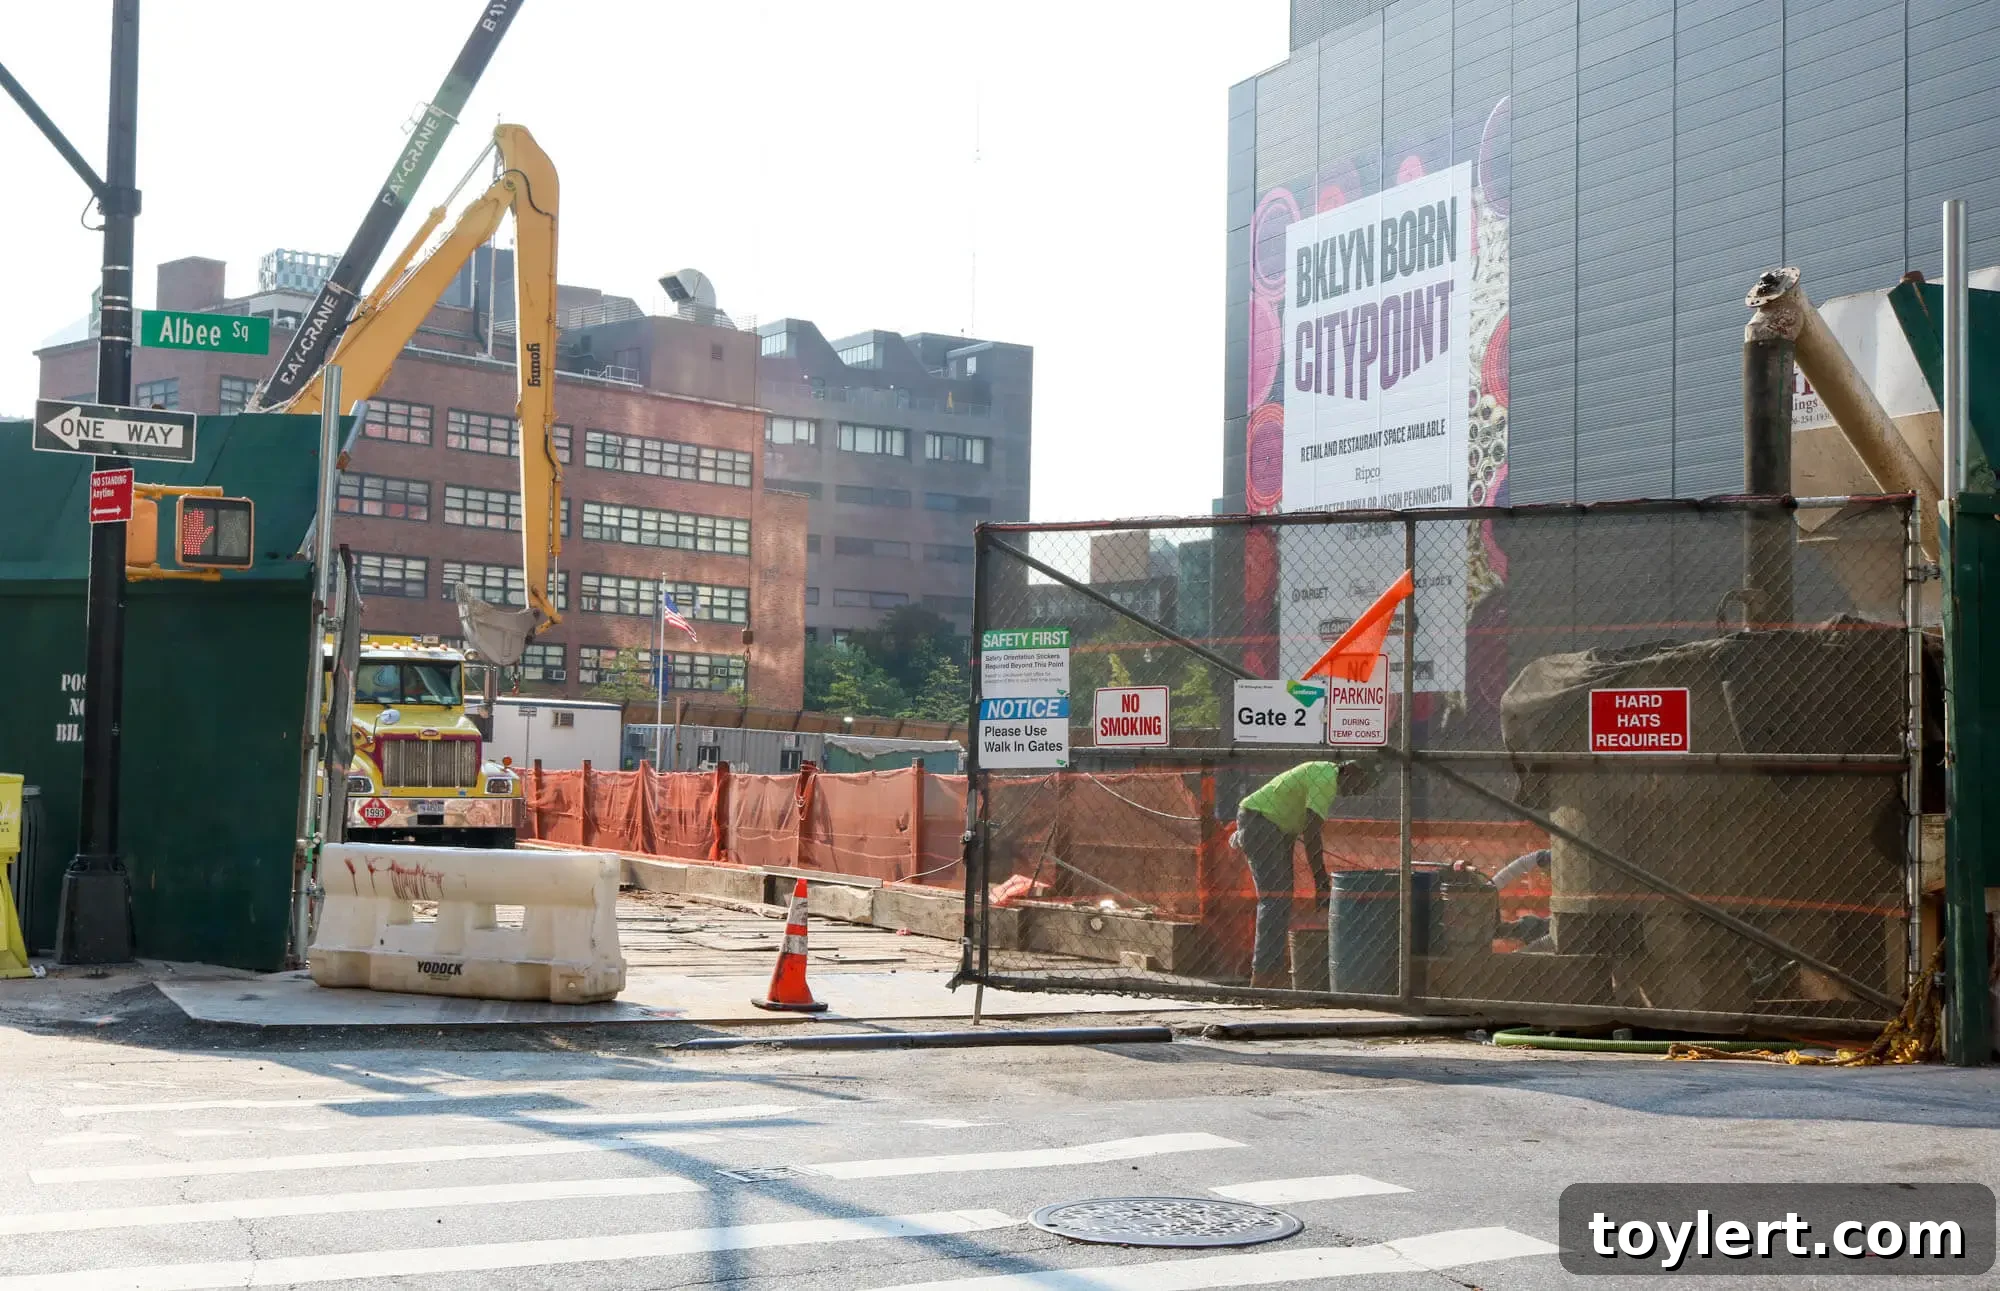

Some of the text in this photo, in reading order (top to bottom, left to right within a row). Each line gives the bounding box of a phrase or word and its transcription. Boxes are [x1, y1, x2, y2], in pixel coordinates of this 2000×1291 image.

[1296, 196, 1458, 308] BKLYN BORN
[159, 316, 249, 346] Albee Sq
[1794, 398, 1818, 413] ings
[61, 417, 174, 445] ONE WAY
[1300, 418, 1446, 462] RETAIL AND RESTAURANT SPACE AVAILABLE
[93, 474, 128, 487] NO STANDING
[1355, 465, 1381, 484] Ripco
[93, 488, 115, 500] Anytime
[1378, 491, 1402, 510] JASON
[1403, 484, 1453, 507] PENNINGTON
[983, 630, 1070, 648] SAFETY FIRST
[1011, 662, 1033, 670] Beyond
[61, 673, 87, 692] POS
[1122, 693, 1140, 713] NO
[1333, 687, 1384, 705] PARKING
[1615, 694, 1663, 708] HARD
[987, 699, 1060, 718] NOTICE
[1238, 707, 1306, 726] Gate 2
[1100, 715, 1162, 737] SMOKING
[1342, 718, 1370, 726] DURING
[1617, 714, 1661, 728] HATS
[56, 723, 82, 742] BIL
[984, 725, 1047, 737] Please Use
[1333, 730, 1353, 738] TEMP
[1596, 733, 1683, 747] REQUIRED
[985, 740, 1063, 752] Walk In Gates
[366, 808, 385, 817] 1993
[418, 961, 463, 975] YODOCK
